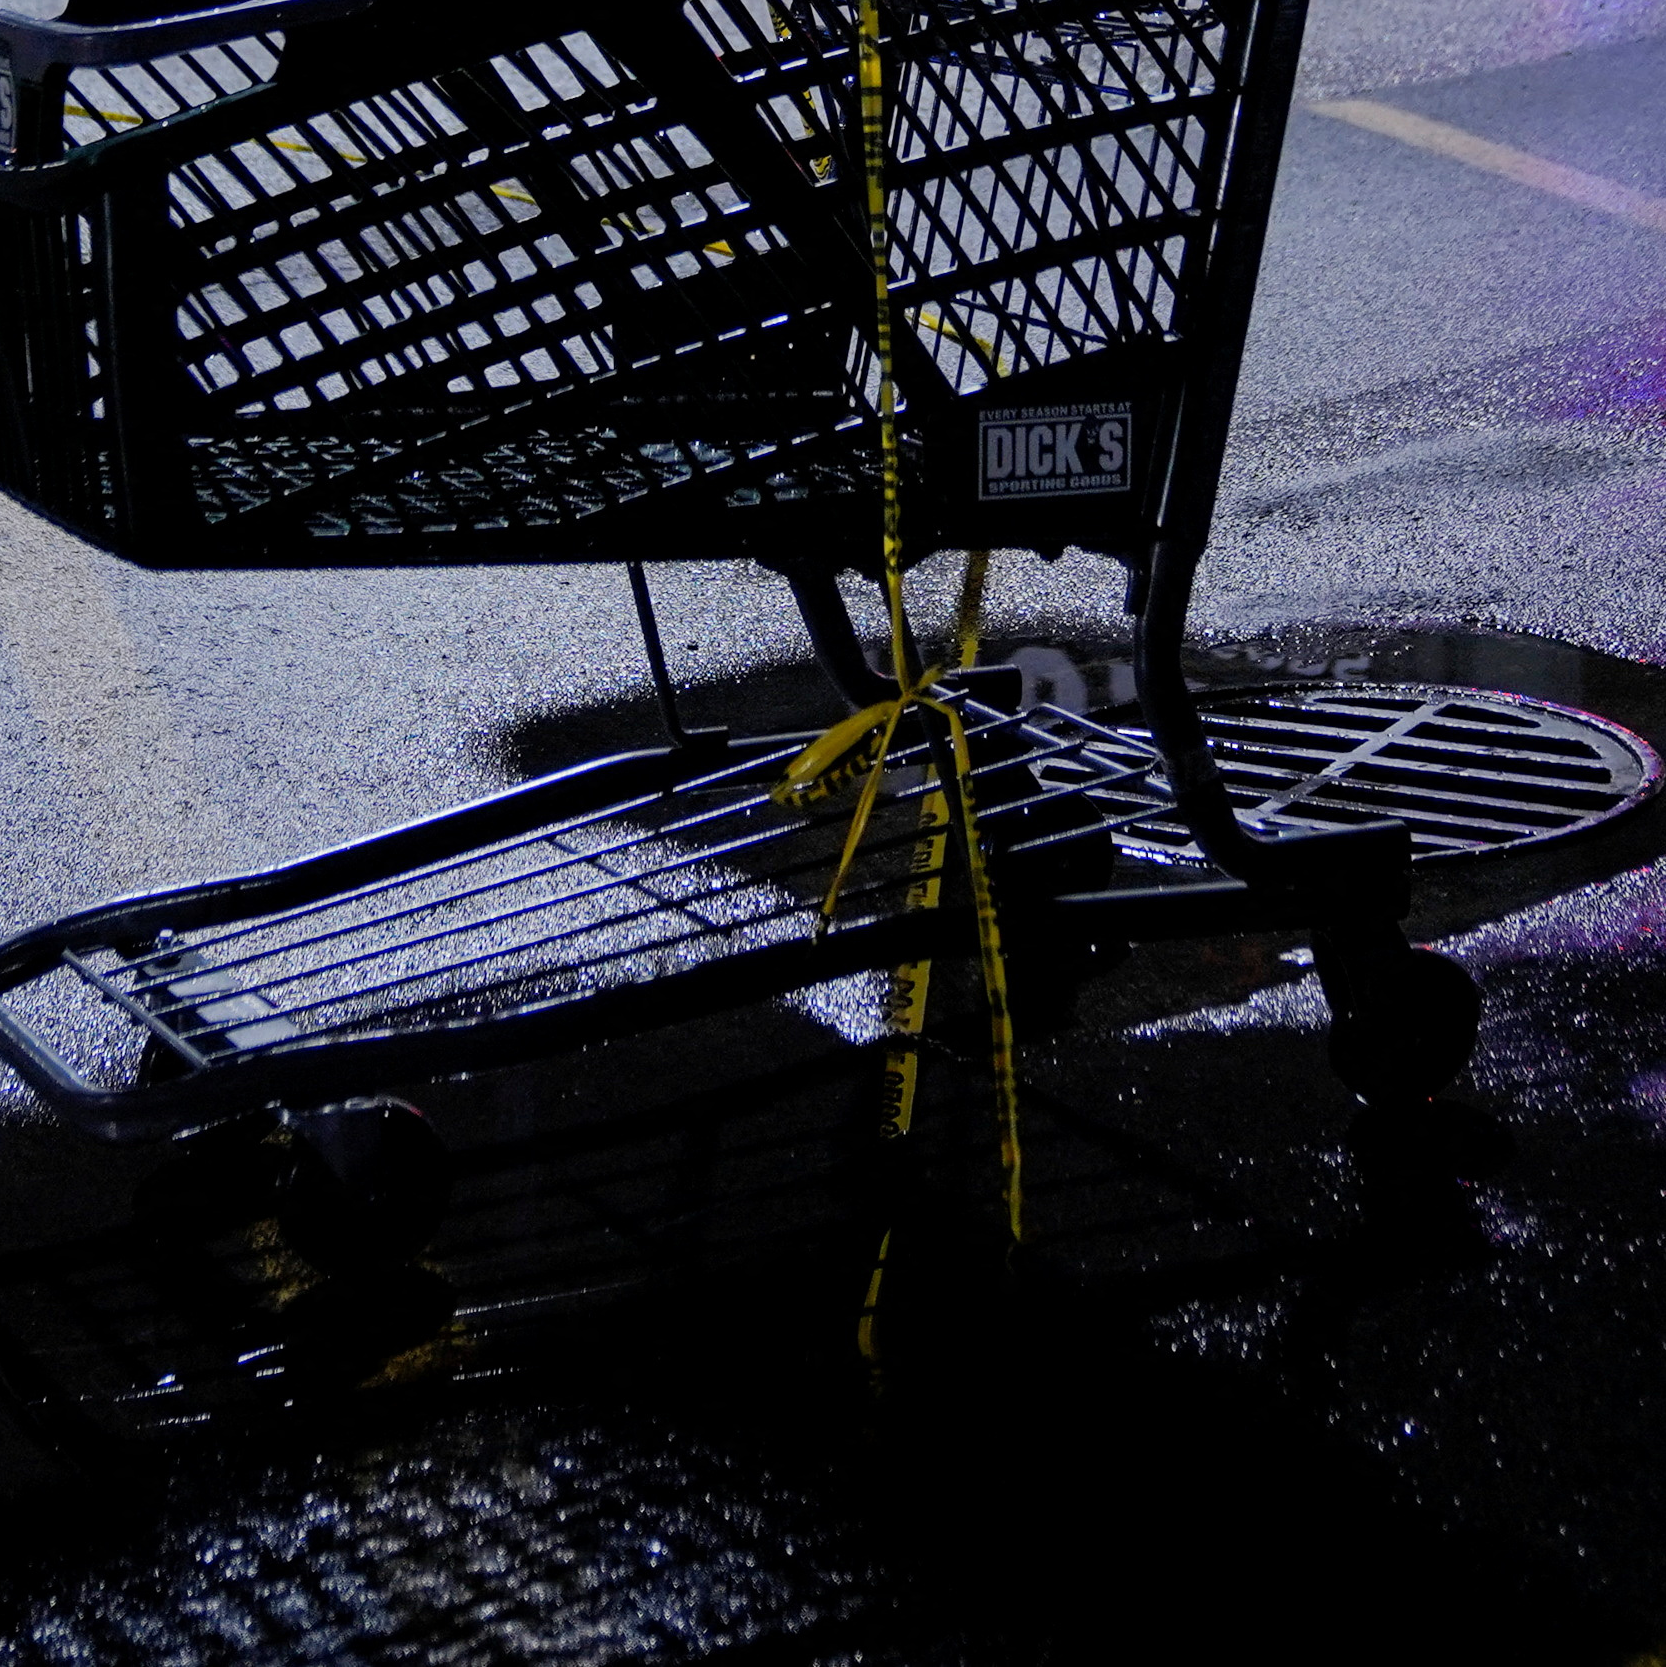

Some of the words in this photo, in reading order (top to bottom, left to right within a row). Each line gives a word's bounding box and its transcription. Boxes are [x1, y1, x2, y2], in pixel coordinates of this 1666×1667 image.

[978, 407, 1018, 422] EVERY
[1020, 404, 1069, 420] SEASON
[1070, 402, 1115, 417] STARTS
[1116, 401, 1132, 414] AT
[986, 420, 1124, 480] DICK'S
[988, 477, 1066, 494] SPORTING
[1069, 473, 1122, 489] GOODS
